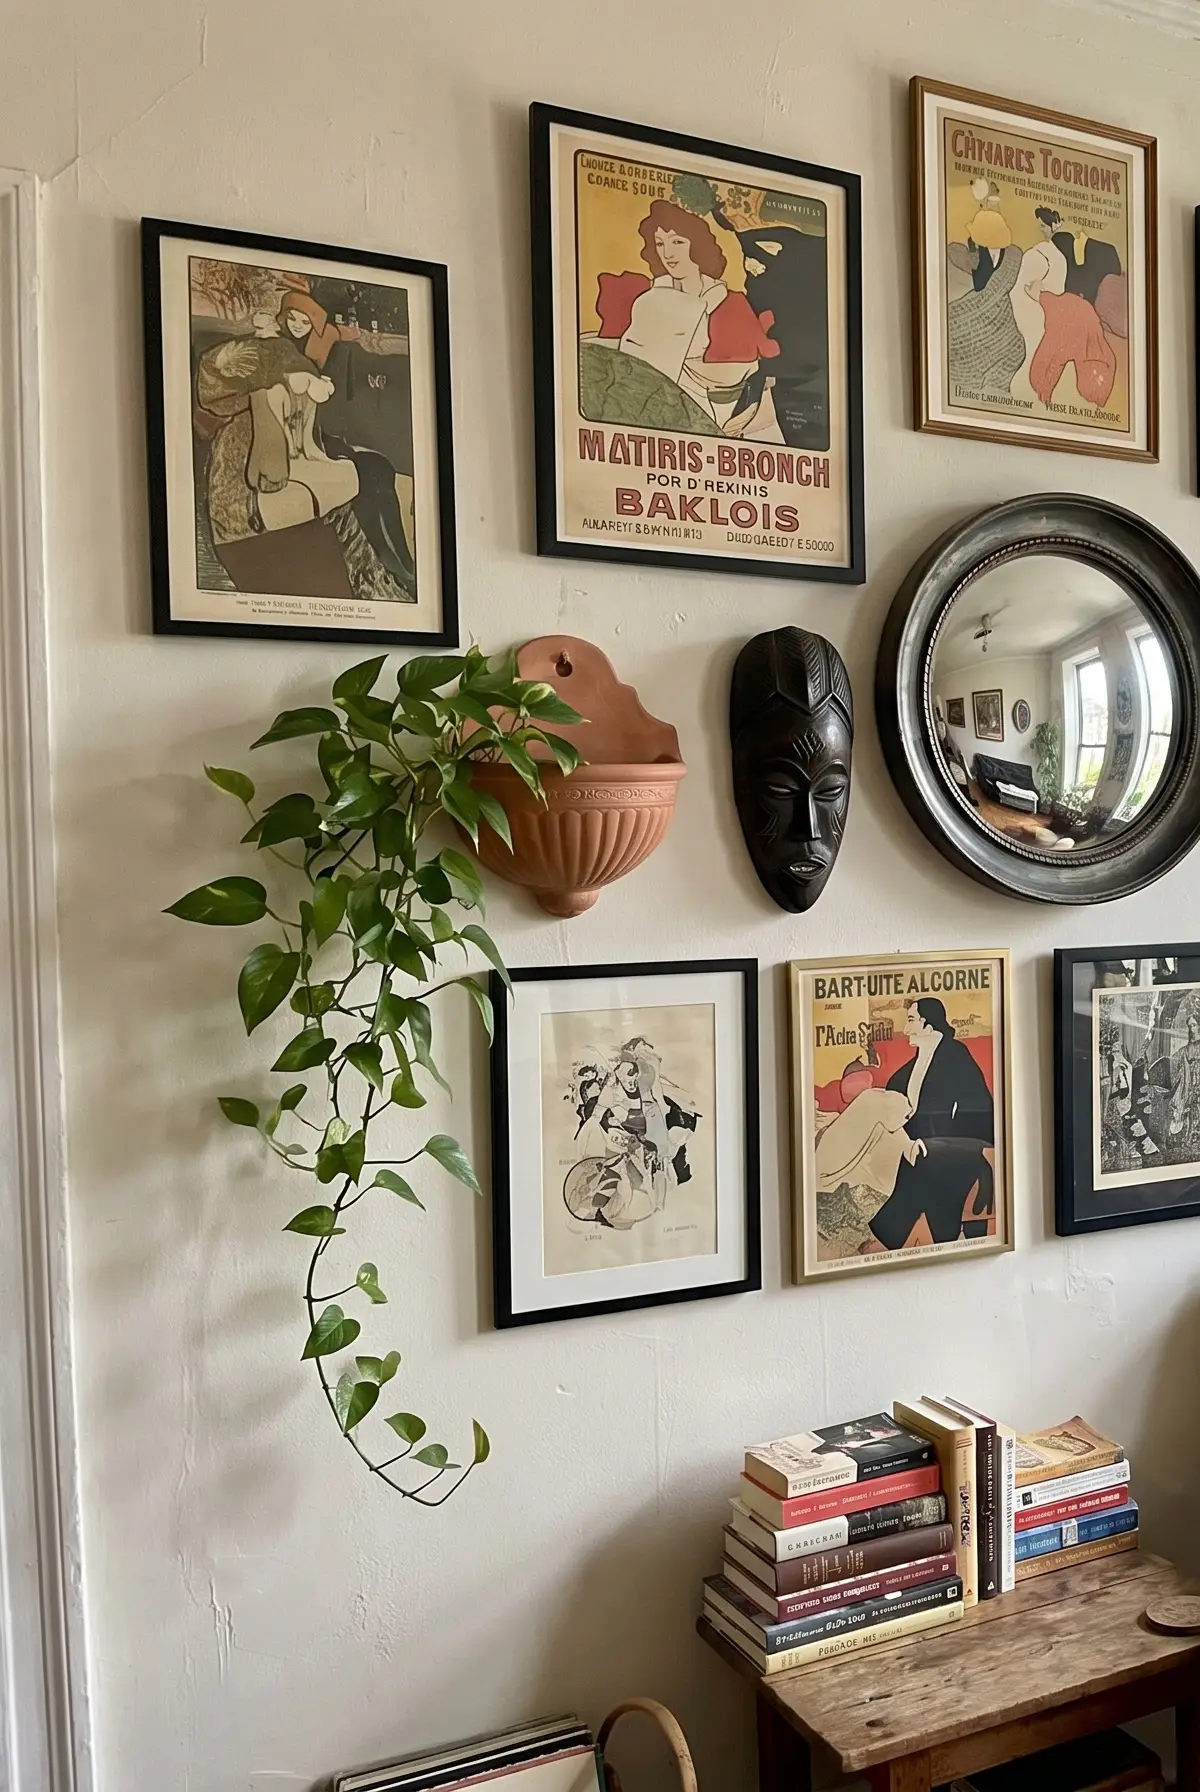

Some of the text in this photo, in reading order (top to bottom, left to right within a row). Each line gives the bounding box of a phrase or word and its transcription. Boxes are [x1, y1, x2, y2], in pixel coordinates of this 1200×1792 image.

[646, 473, 682, 489] POR
[615, 487, 801, 532] BAKLOIS
[906, 967, 991, 994] ALCORNE
